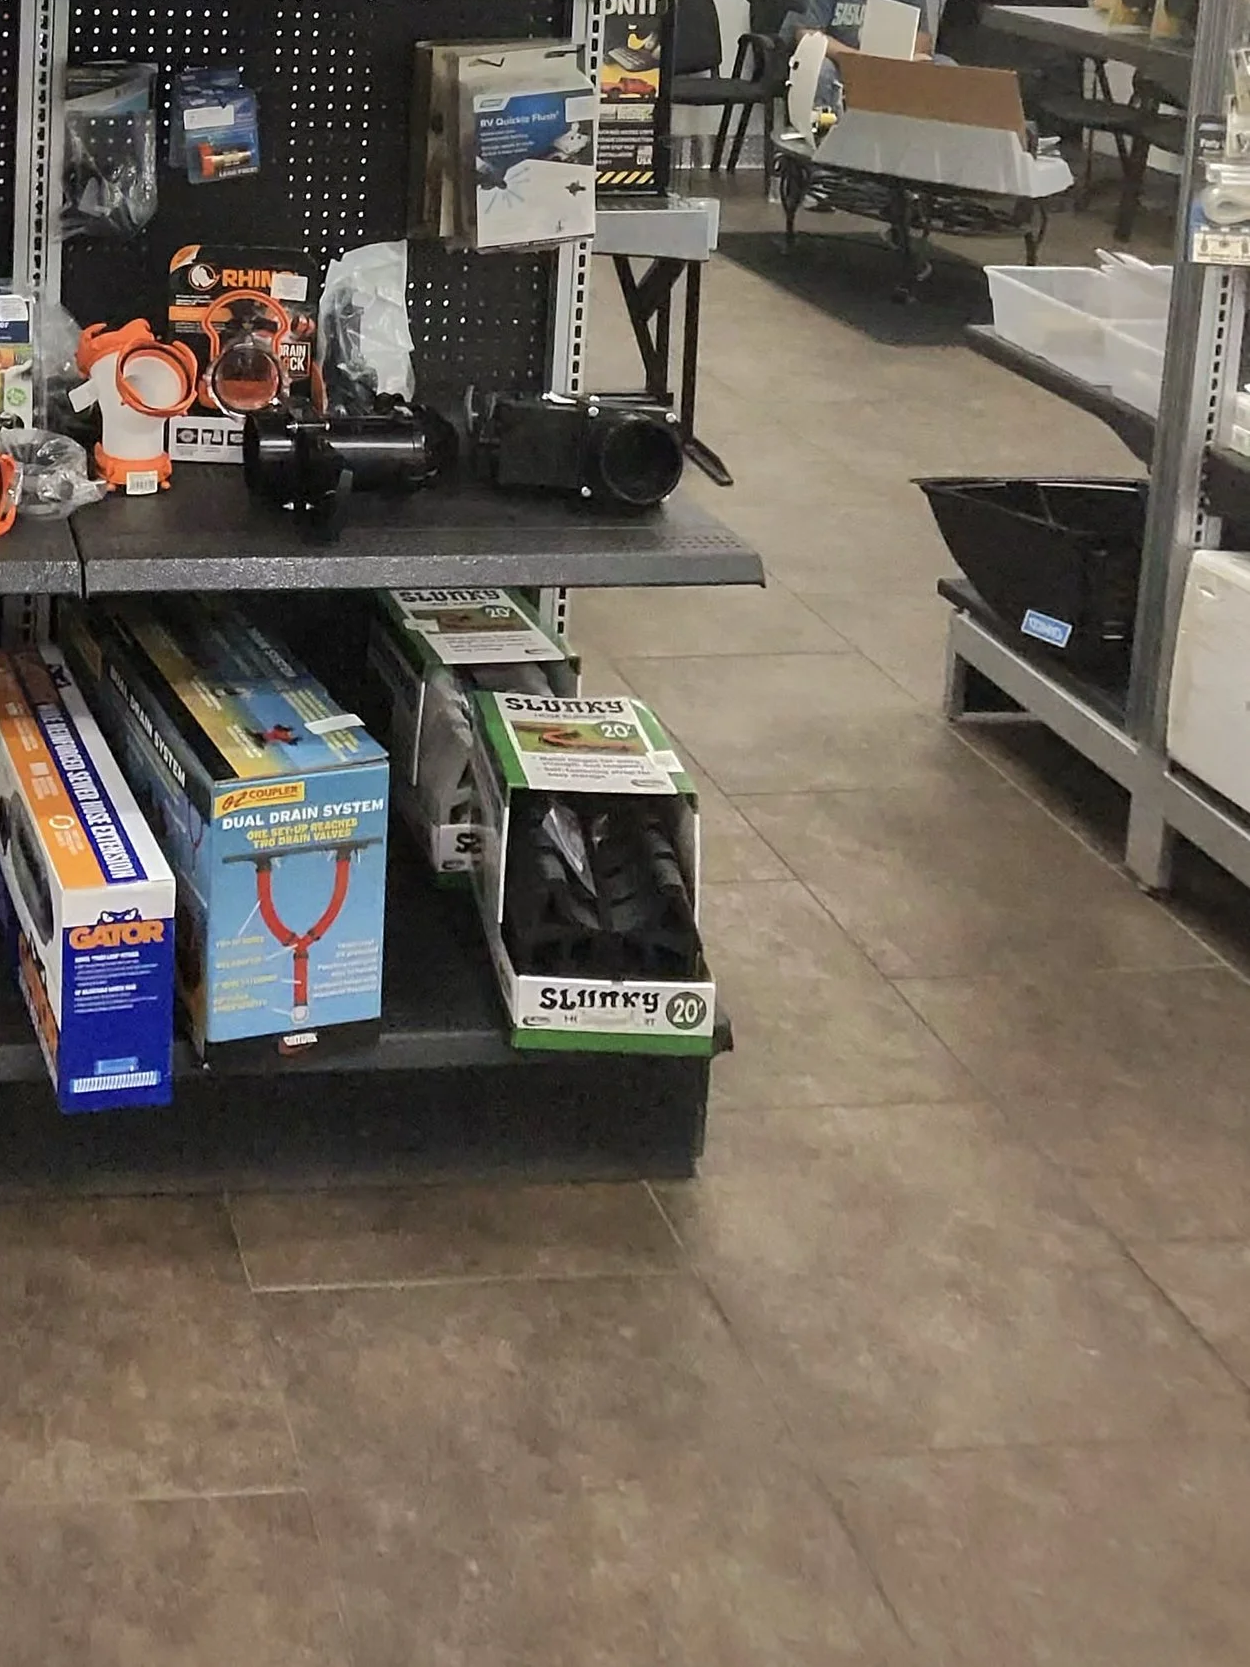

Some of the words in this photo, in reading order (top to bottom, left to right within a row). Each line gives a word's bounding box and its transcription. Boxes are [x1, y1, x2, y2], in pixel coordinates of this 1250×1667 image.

[480, 117, 495, 128] RV
[222, 269, 290, 288] RHIN
[504, 697, 625, 714] SLUNKY
[153, 729, 186, 789] SYSTEM
[249, 785, 299, 800] COUPLER
[222, 813, 265, 831] DUAL
[269, 808, 318, 824] DRAIN
[322, 798, 384, 817] SYSTEM
[69, 920, 165, 950] GATOR
[539, 987, 661, 1014] SLUNKY
